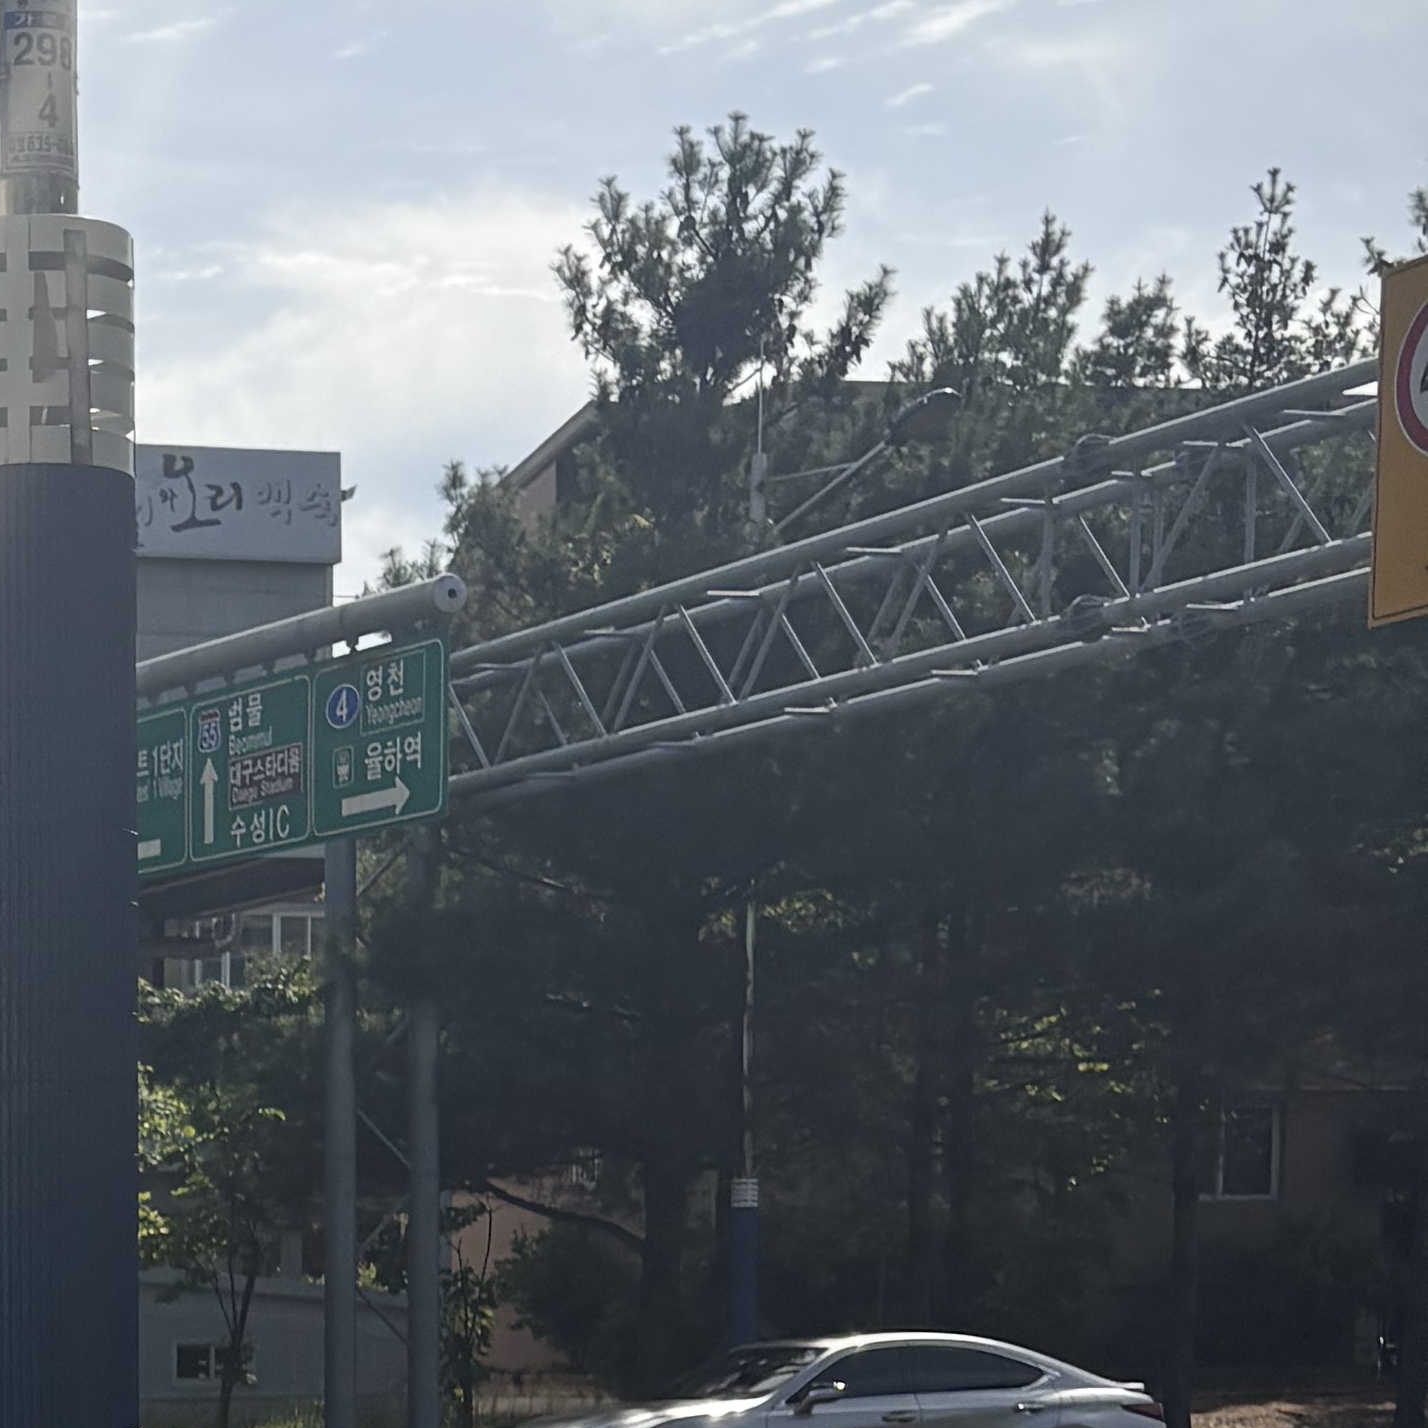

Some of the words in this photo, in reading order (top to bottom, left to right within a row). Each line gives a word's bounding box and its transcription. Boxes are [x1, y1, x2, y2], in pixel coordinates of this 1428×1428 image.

[38, 93, 59, 128] 4
[366, 659, 404, 701] 영천
[228, 692, 263, 732] 범물
[336, 689, 348, 723] 4
[229, 747, 301, 787] 대구스타디움
[365, 731, 422, 781] 율하역
[230, 804, 290, 849] 수성IC
